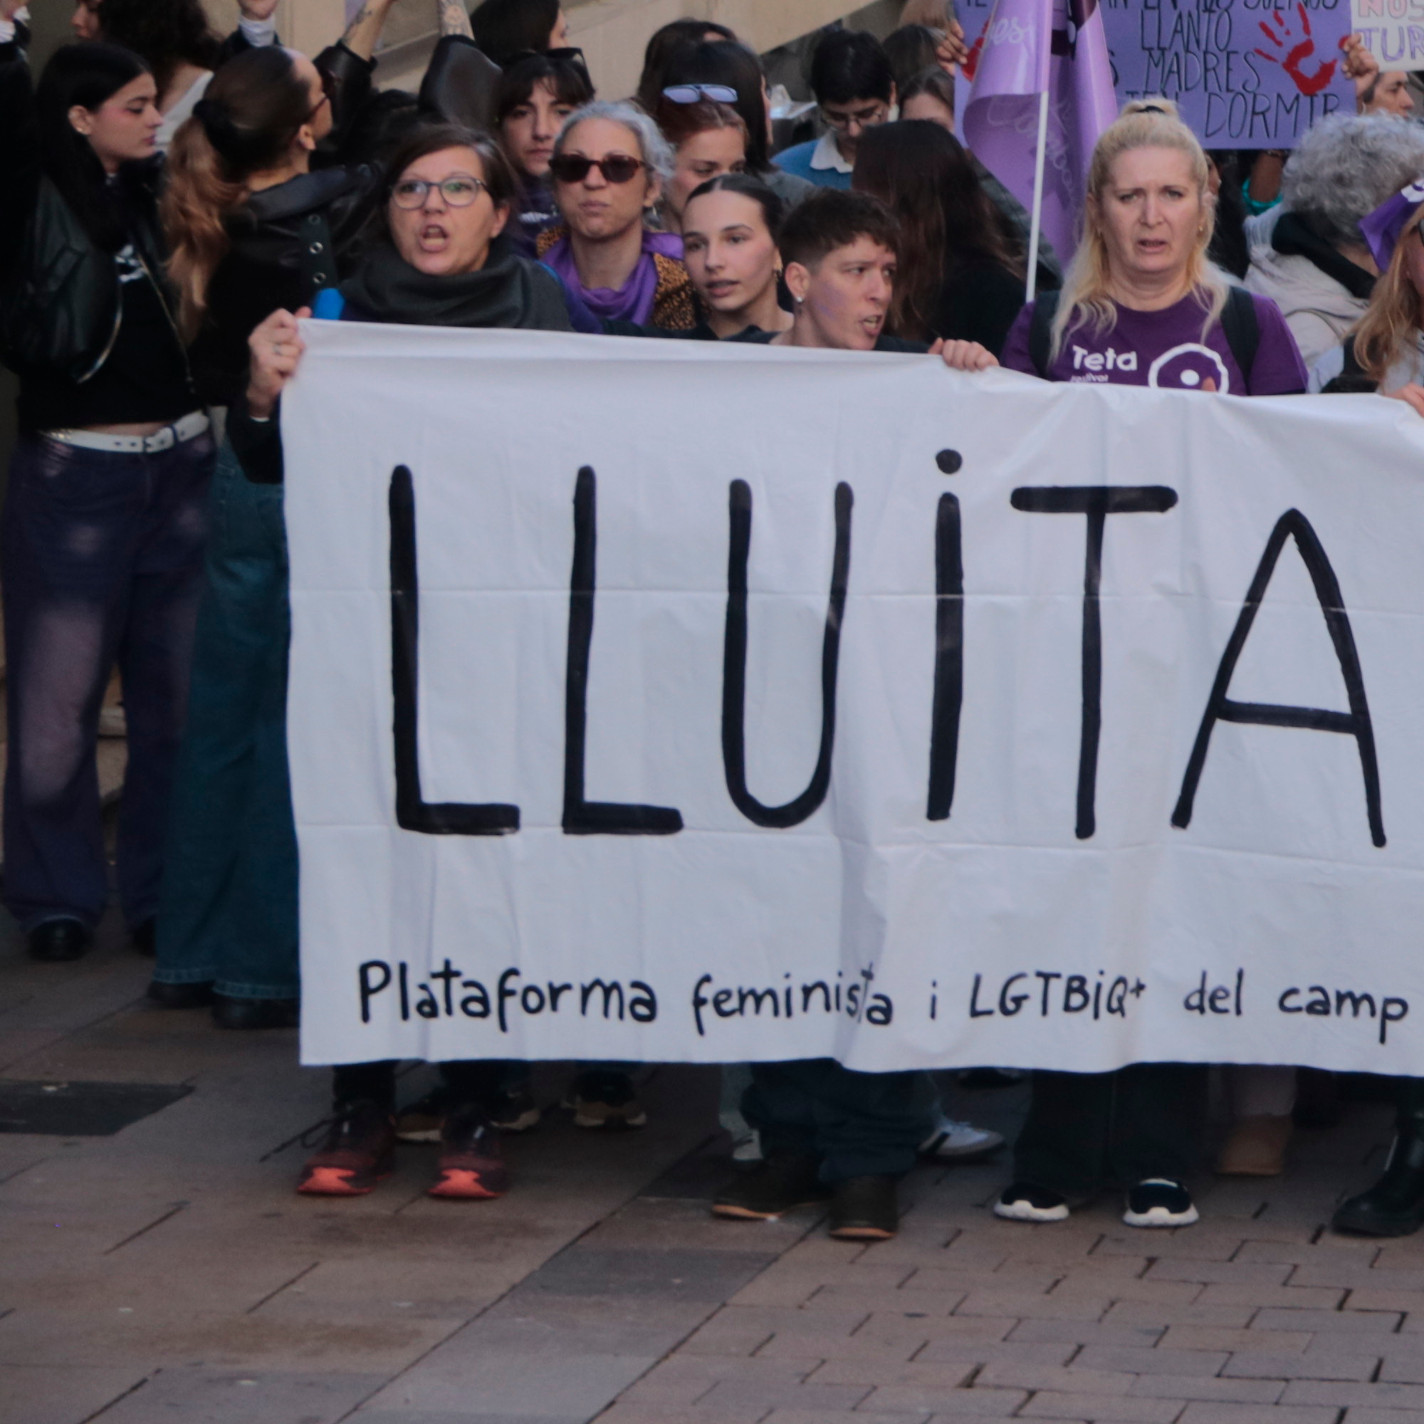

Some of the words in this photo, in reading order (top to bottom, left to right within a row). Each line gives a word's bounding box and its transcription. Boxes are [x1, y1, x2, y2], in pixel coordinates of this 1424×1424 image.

[1140, 9, 1234, 52] LLANTO
[1144, 49, 1262, 94] MADRES
[1072, 344, 1138, 371] Teta
[357, 958, 660, 1033] Plataforma
[690, 960, 895, 1036] feminista
[928, 977, 938, 1022] i
[1182, 968, 1245, 1018] del
[1277, 983, 1410, 1044] camp
